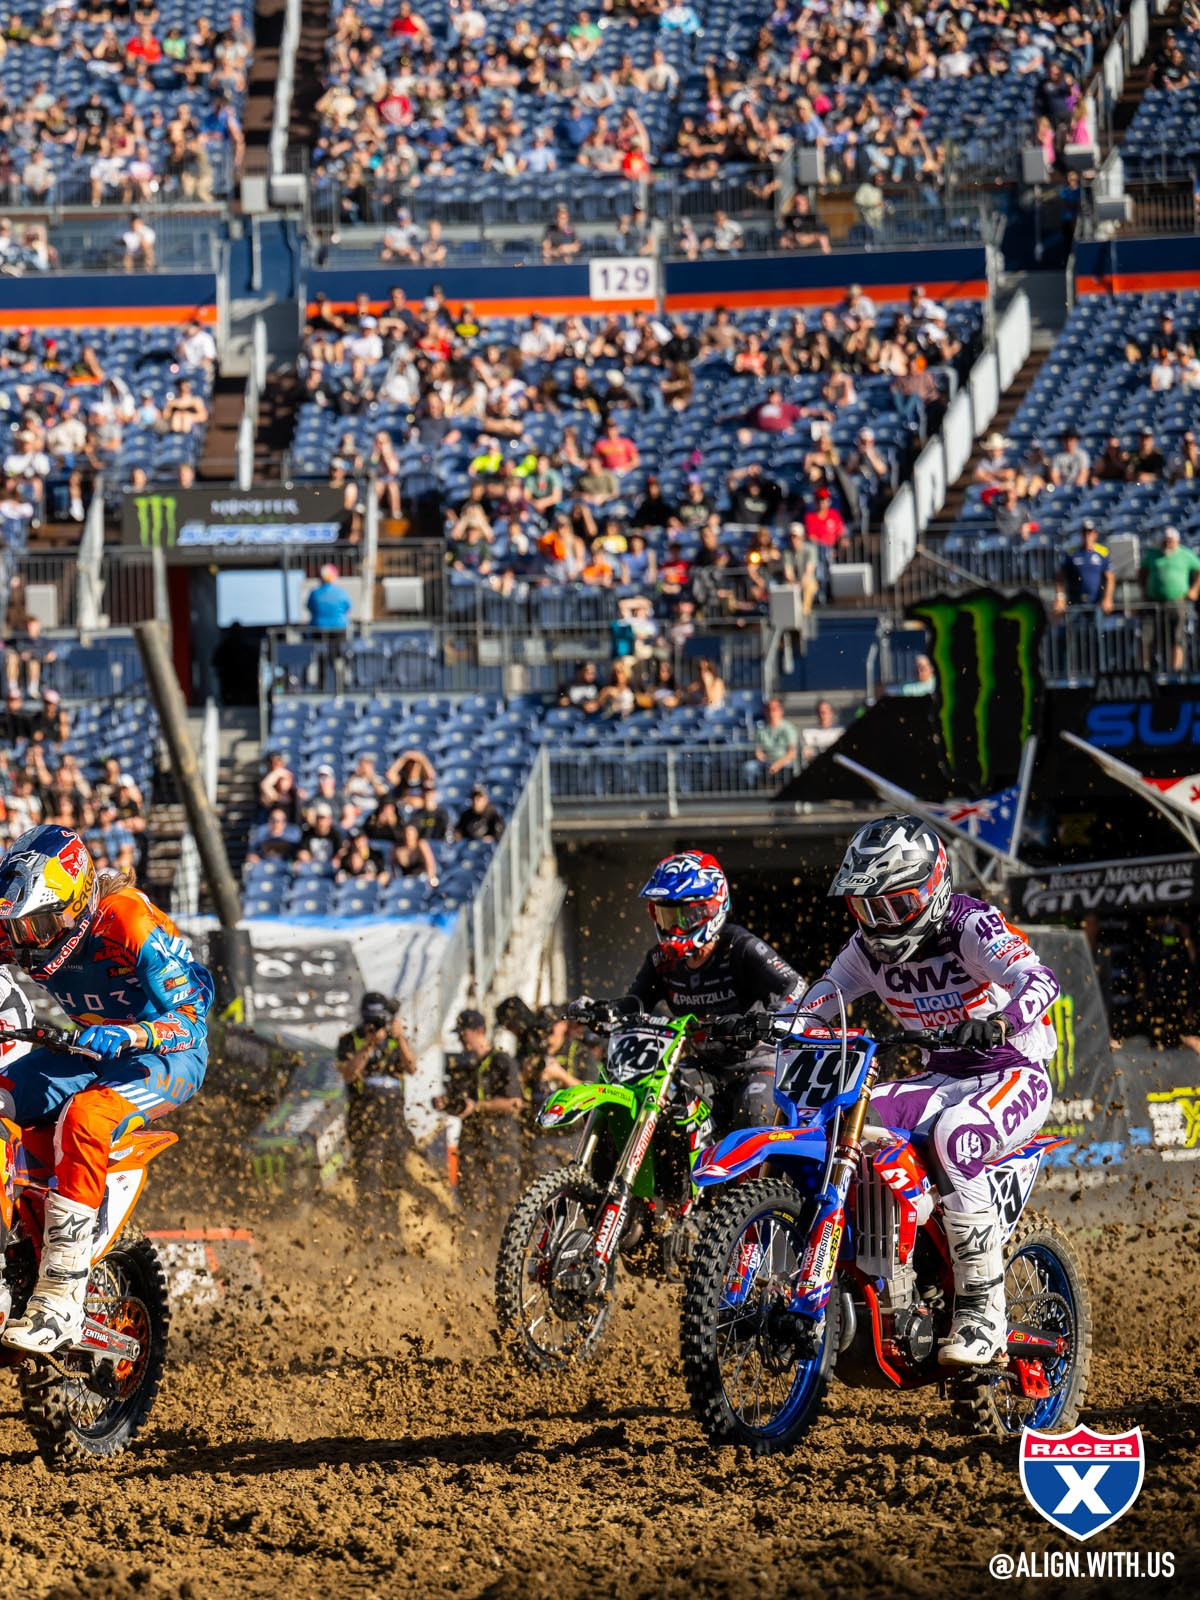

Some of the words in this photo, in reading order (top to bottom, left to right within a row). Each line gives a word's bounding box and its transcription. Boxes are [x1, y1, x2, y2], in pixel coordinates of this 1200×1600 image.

[601, 266, 649, 292] 129
[211, 500, 298, 516] MONSTER
[1096, 676, 1152, 700] AMA
[1050, 872, 1103, 889] ROCKY
[1104, 862, 1194, 885] MOUNTAIN
[975, 913, 1006, 942] 49
[885, 957, 973, 994] CNVS
[679, 988, 736, 1006] PARTZILLA
[916, 993, 960, 1011] LIQUI
[921, 1008, 966, 1027] MOLY
[809, 1027, 860, 1038] Beta
[779, 1050, 859, 1108] 49
[1002, 1073, 1048, 1136] CNVS
[956, 1130, 982, 1166] 49
[596, 1209, 617, 1252] MAXXIS
[814, 1221, 833, 1278] BRIDGESTONE
[825, 1226, 841, 1281] ACERBIS
